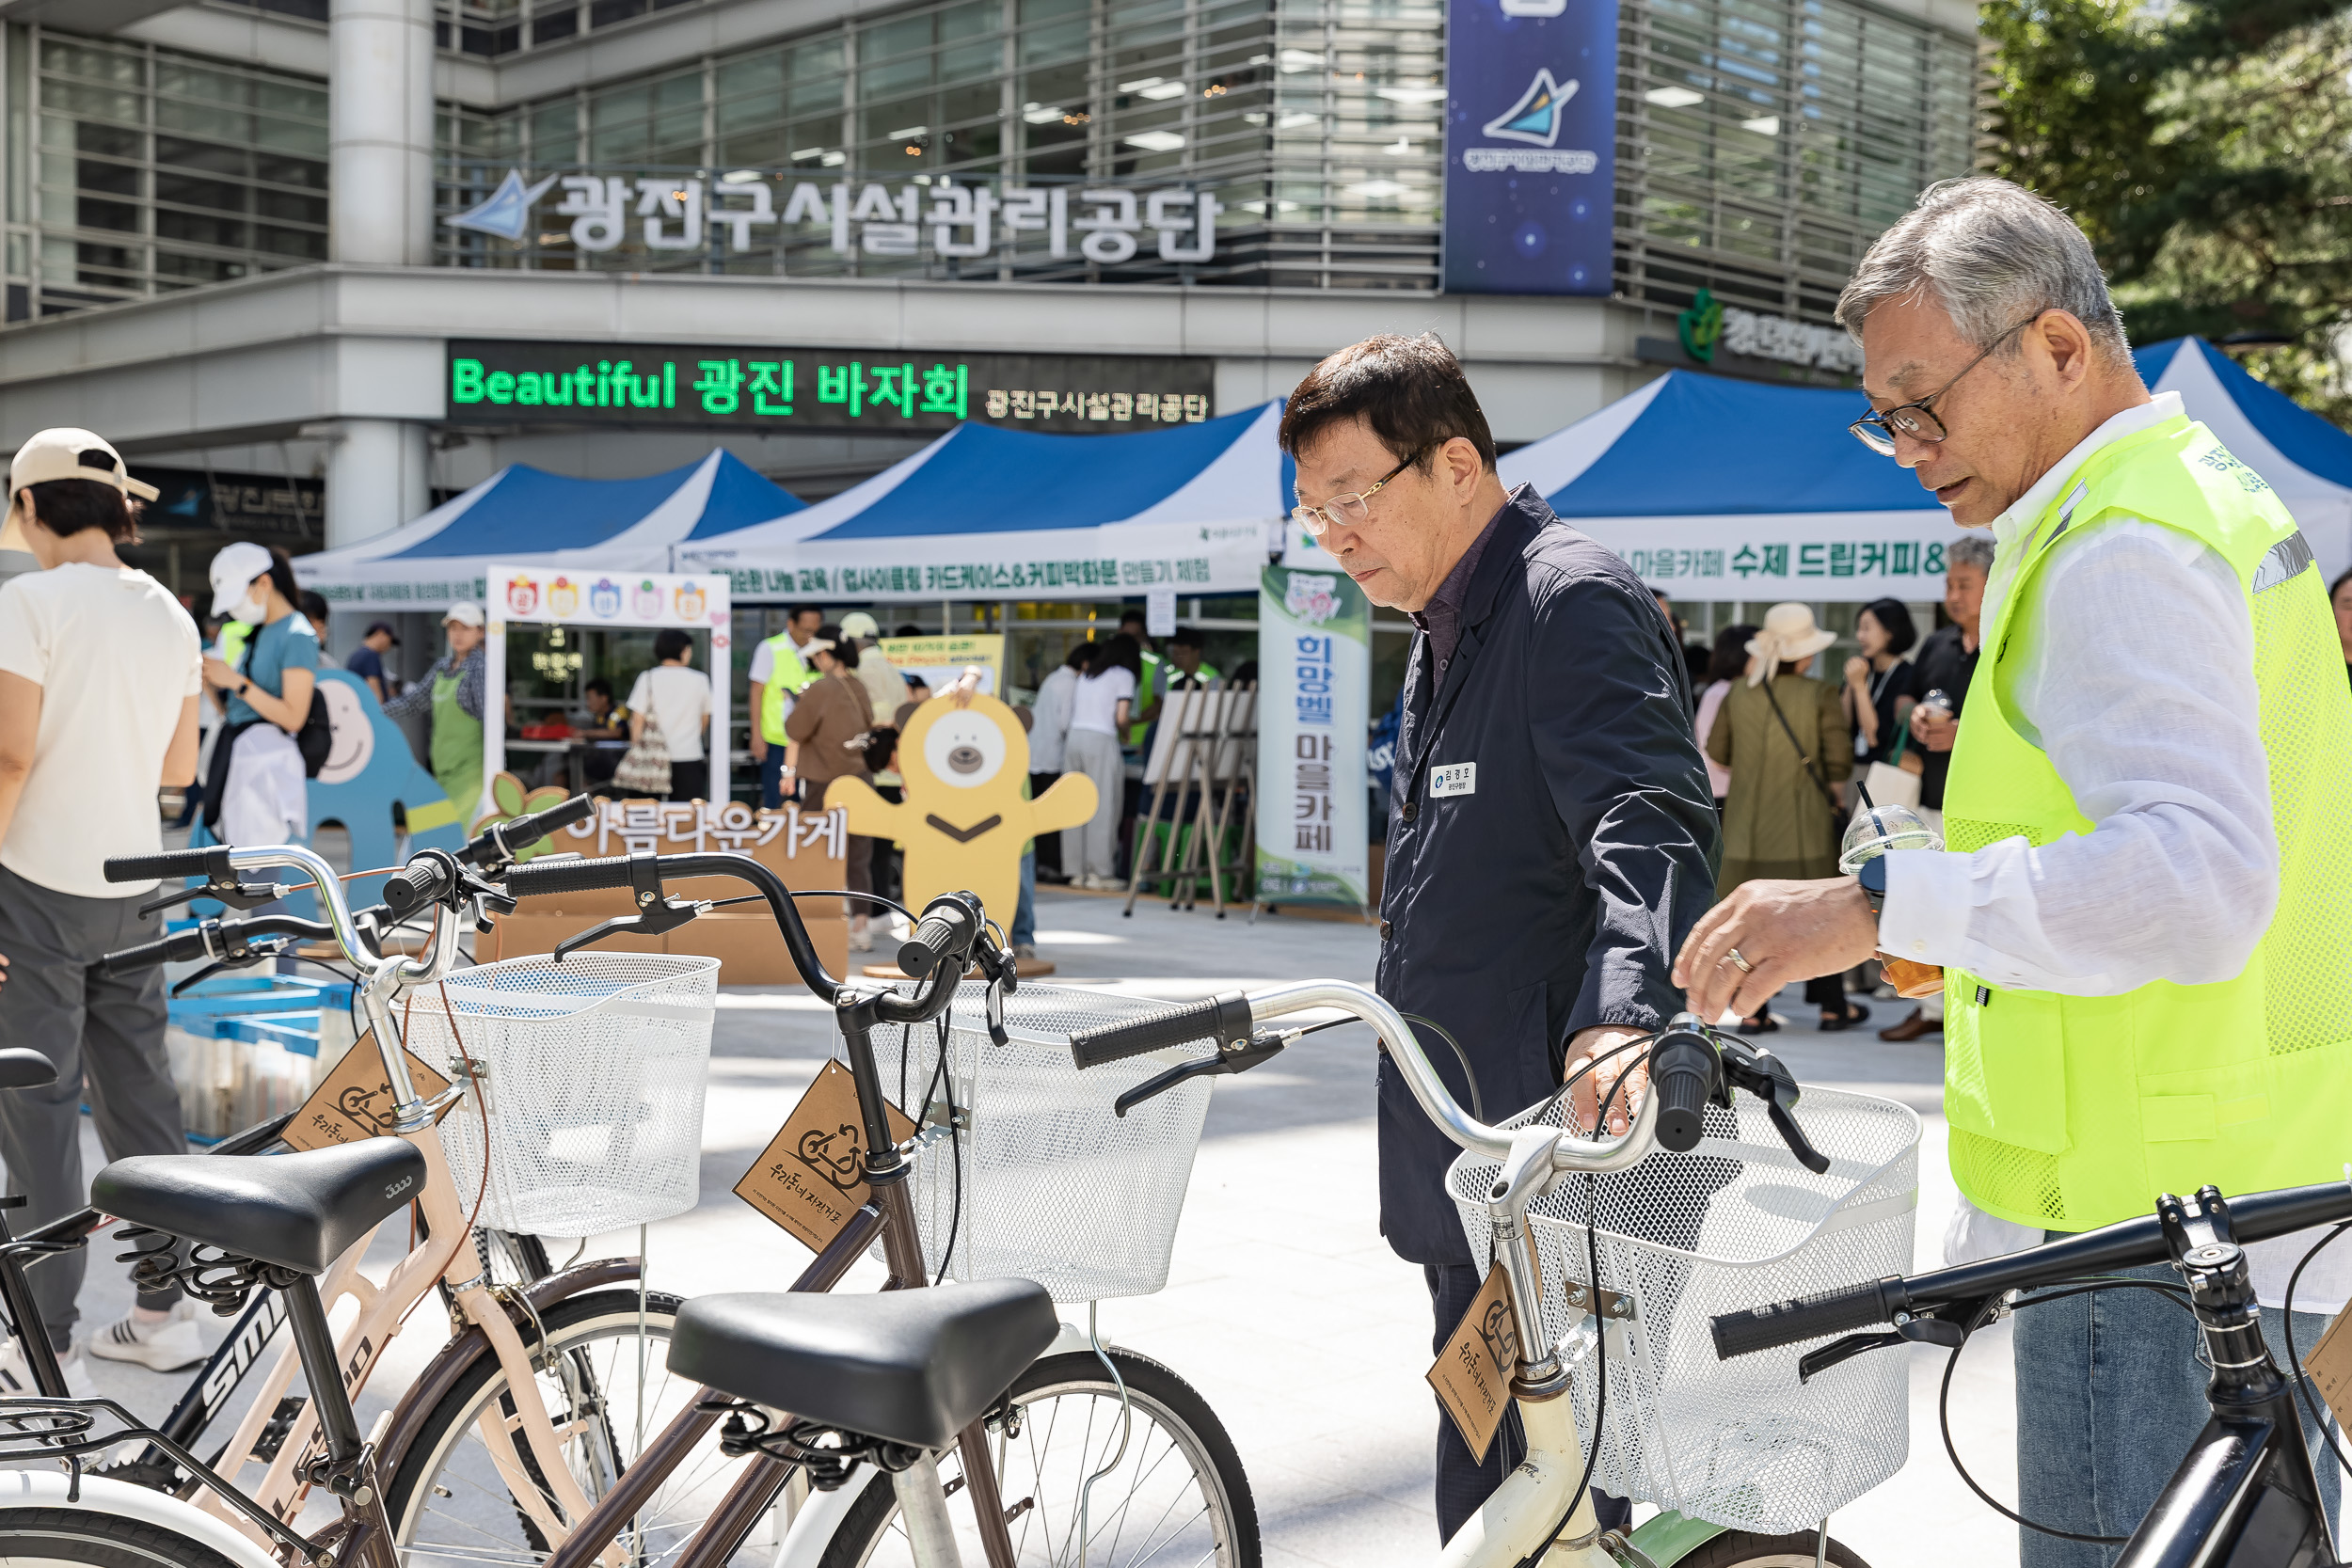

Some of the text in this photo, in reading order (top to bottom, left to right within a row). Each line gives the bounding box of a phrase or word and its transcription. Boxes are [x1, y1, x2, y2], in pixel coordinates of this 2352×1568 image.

[557, 176, 1225, 263] 광진구시설관리공단
[453, 358, 970, 420] Beautiful 광진 바자회
[985, 389, 1210, 423] 광진구시설관리공단
[1631, 541, 1947, 579] 마을카페 수제 드립커피&
[1295, 635, 1333, 725] 희망벨
[1295, 734, 1337, 852] 마을카페
[566, 800, 848, 860] 아름다운가게
[770, 1163, 842, 1226] 우리동네 자전거포
[1458, 1341, 1482, 1385] 우리동네
[1477, 1376, 1497, 1418] 자전거포
